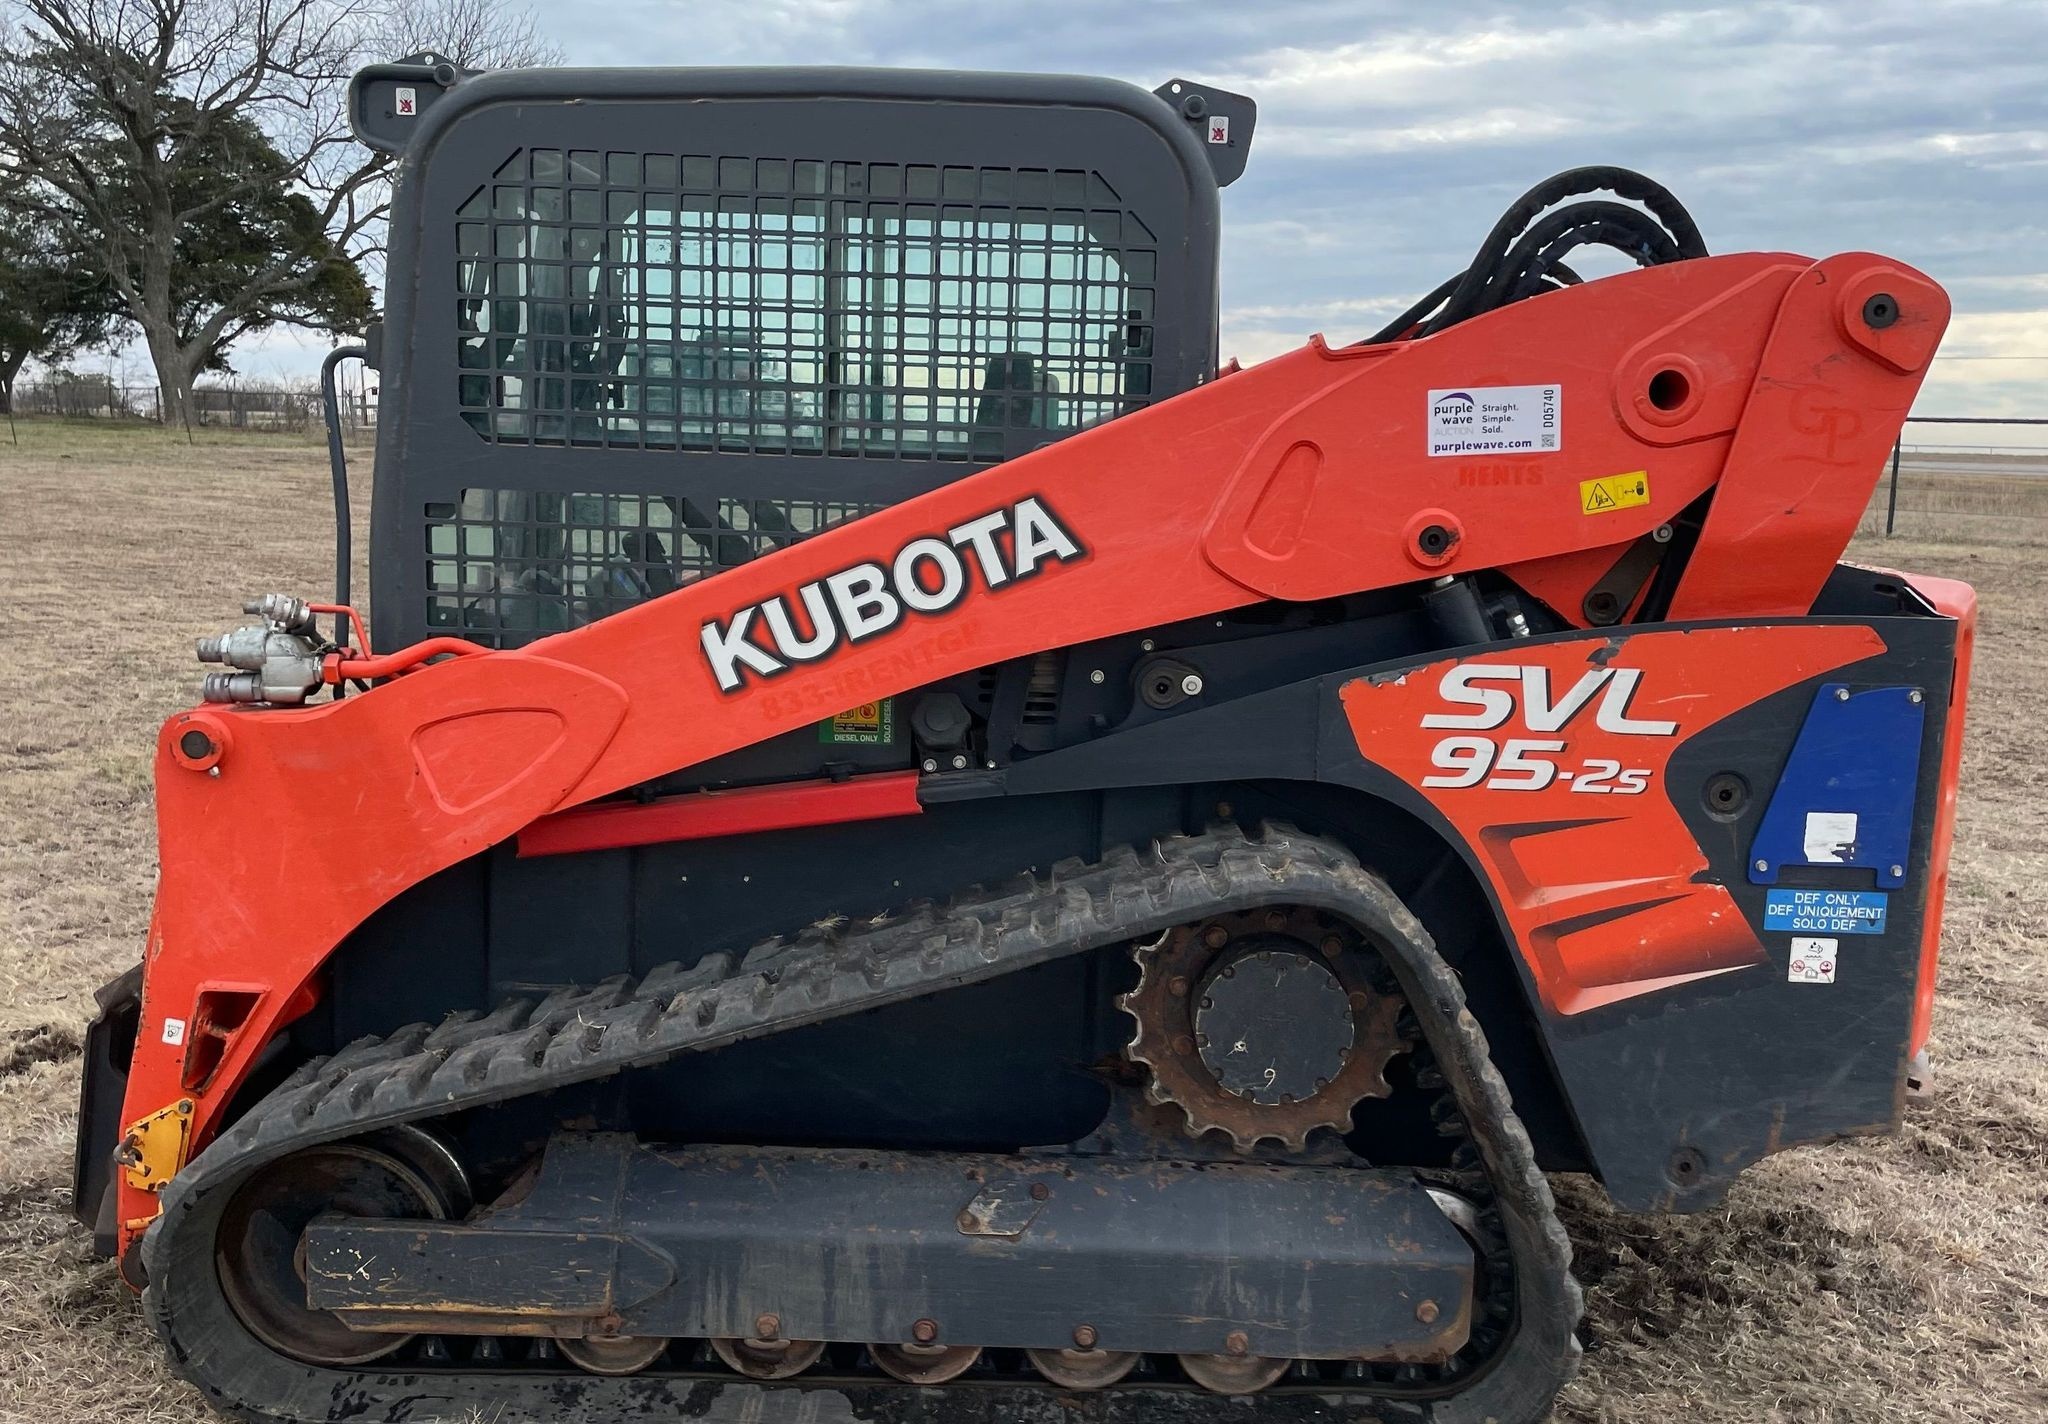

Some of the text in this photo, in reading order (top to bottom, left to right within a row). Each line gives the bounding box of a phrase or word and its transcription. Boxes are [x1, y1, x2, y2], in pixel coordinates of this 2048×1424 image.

[1434, 402, 1473, 416] purple
[1482, 403, 1519, 413] Straight.
[1543, 389, 1554, 428] DQ5740
[1441, 416, 1473, 425] wave
[1482, 415, 1514, 424] Simple.
[1434, 426, 1474, 436] AUCTION
[1482, 425, 1504, 434] Sold.
[1434, 440, 1532, 454] purplewave.com
[1458, 464, 1545, 487] RENTS
[700, 496, 1080, 692] KUBOTA
[1420, 663, 1681, 736] SVL
[834, 734, 879, 742] DIESEL ONLY
[1794, 892, 1821, 904] DEF
[1768, 904, 1884, 919] DEF UNIQUEMENT
[1793, 918, 1857, 931] SOLO DEF
